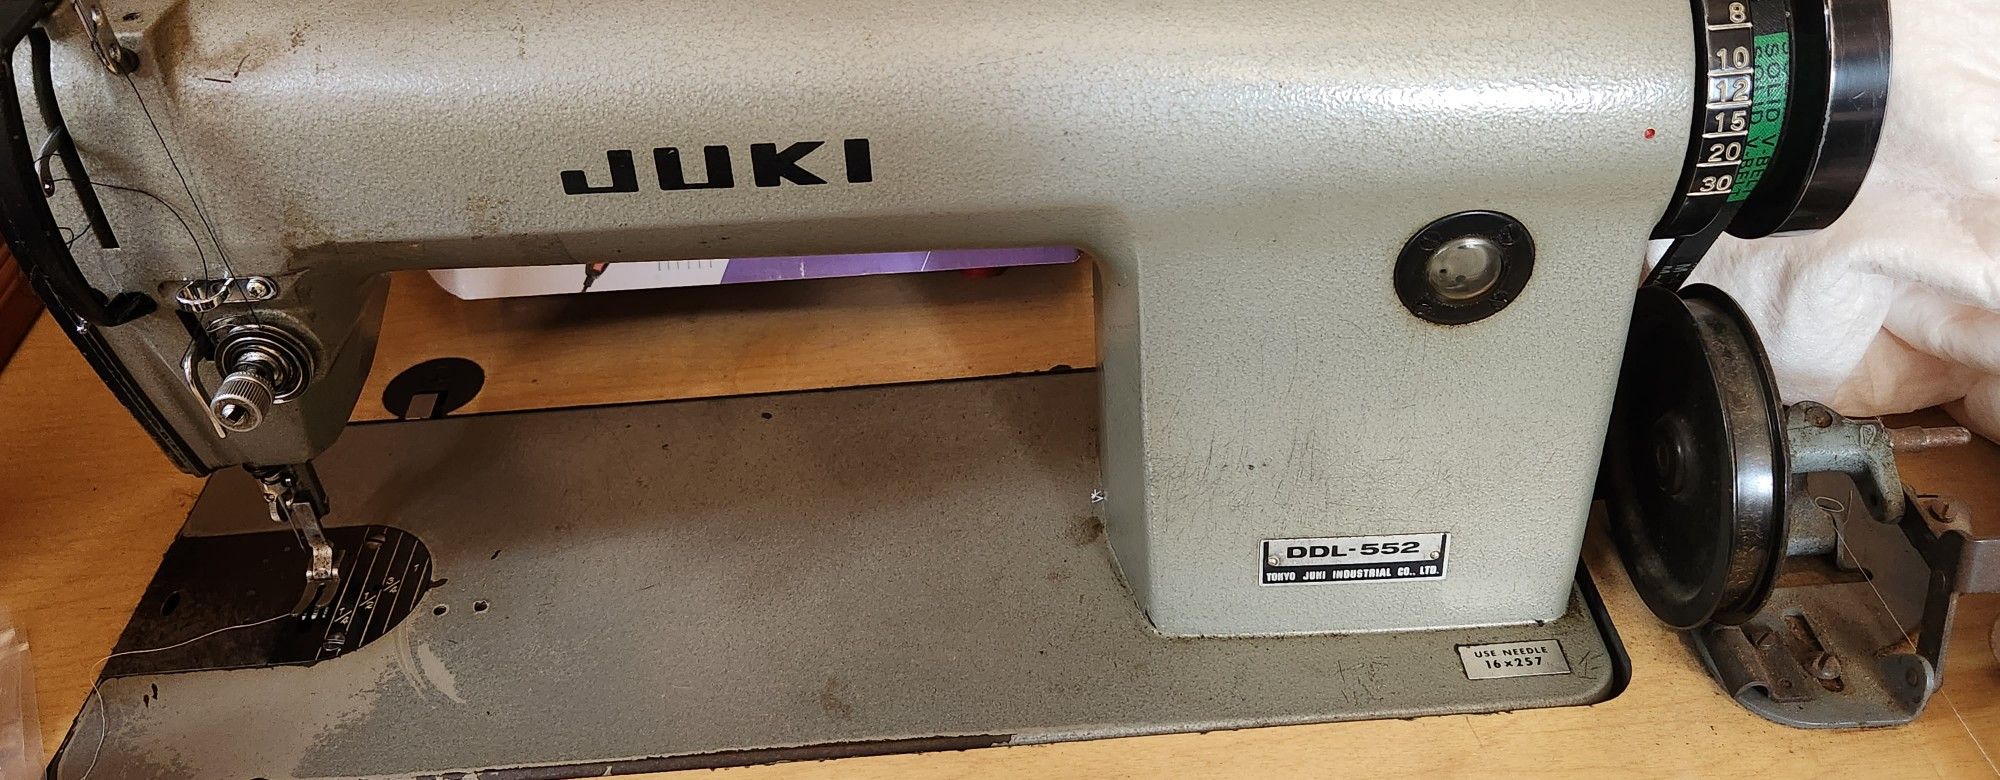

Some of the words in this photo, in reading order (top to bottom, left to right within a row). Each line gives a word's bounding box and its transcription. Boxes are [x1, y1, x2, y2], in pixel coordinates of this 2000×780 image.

[1729, 2, 1746, 24] 8
[1716, 46, 1750, 70] 10
[1716, 79, 1748, 101] 12
[1715, 110, 1746, 132] 15
[1707, 142, 1741, 162] 20
[560, 138, 873, 195] JUKI
[1700, 175, 1733, 192] 30
[1286, 541, 1420, 559] DDL-552
[1266, 571, 1296, 582] TOKYO
[1302, 570, 1326, 580] JUKI
[1332, 567, 1391, 580] INDUSTRIAL
[1419, 565, 1440, 575] LTD.
[1473, 650, 1496, 658] USE
[1502, 646, 1549, 656] NEEDLE
